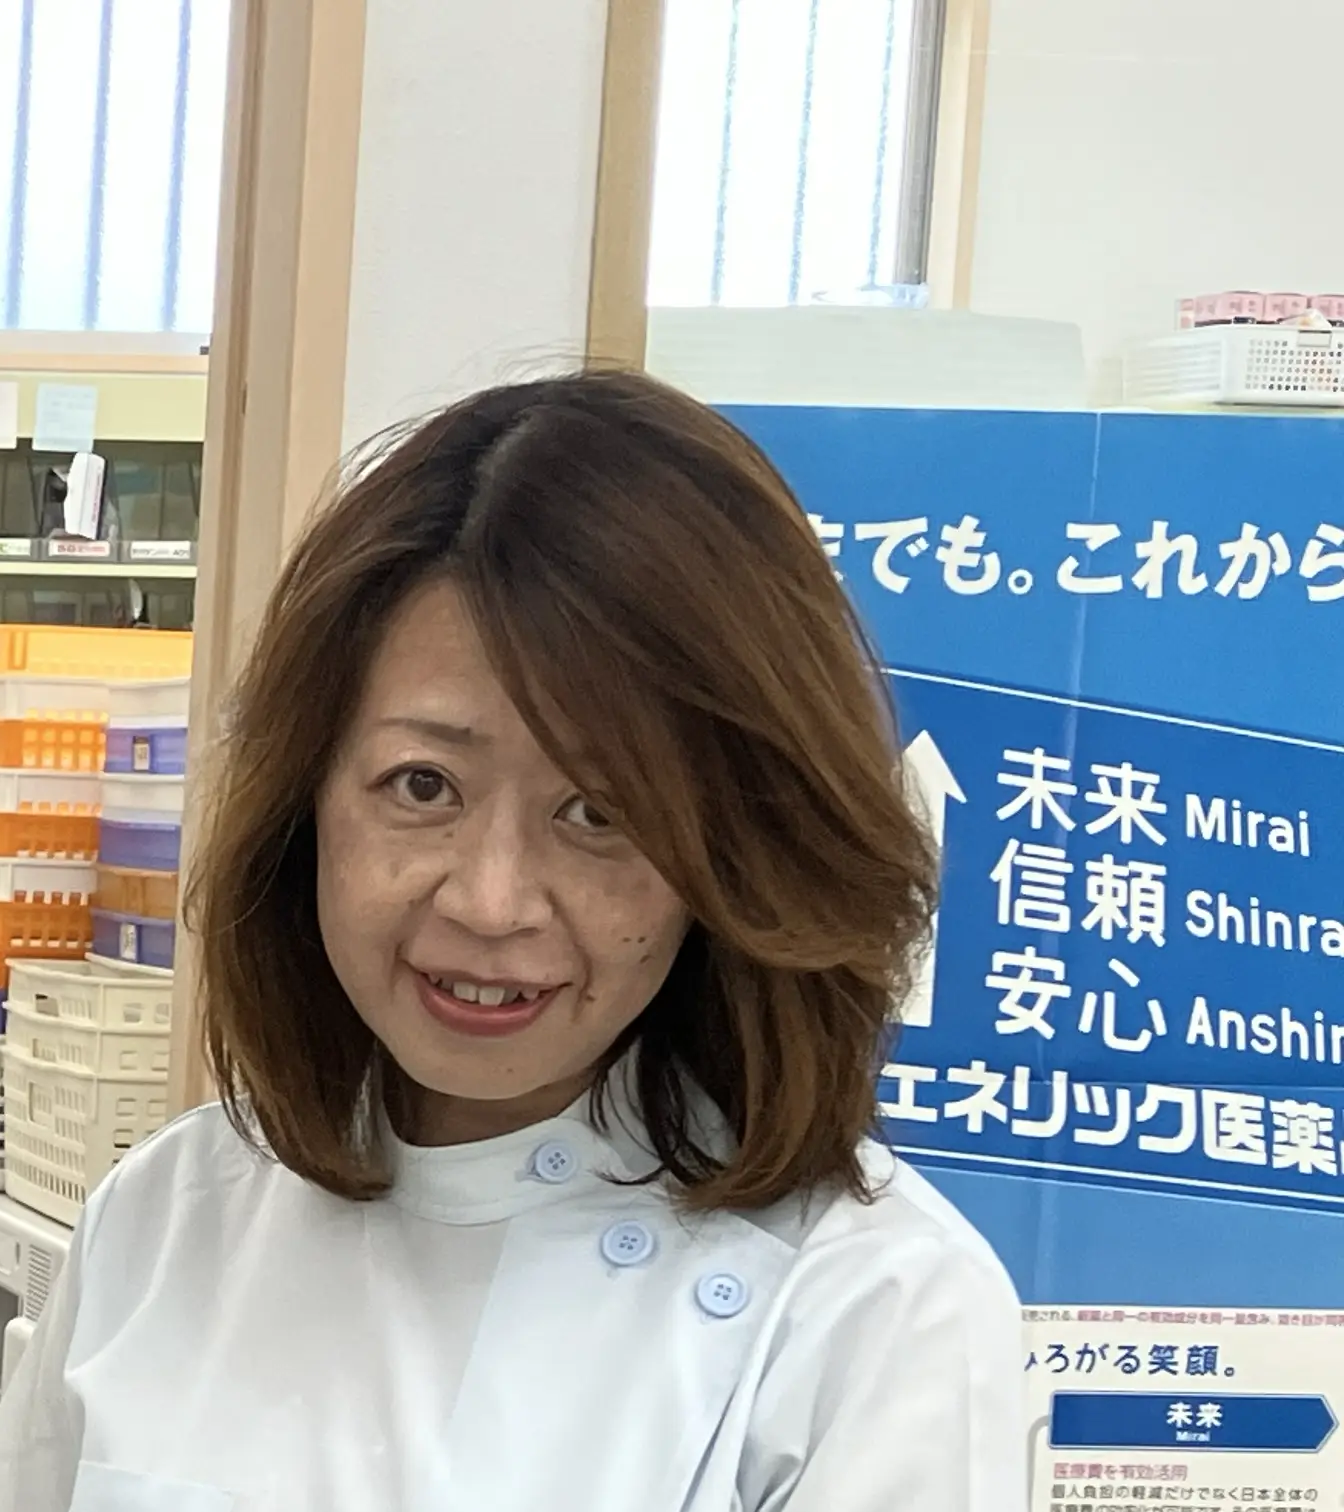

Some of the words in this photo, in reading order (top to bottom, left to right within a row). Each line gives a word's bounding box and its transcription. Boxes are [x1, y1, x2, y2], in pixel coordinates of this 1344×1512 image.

[995, 747, 1168, 847] 未来
[1184, 793, 1311, 858] Mirai
[989, 838, 1168, 948] 信頼
[1184, 888, 1344, 958] Shinra
[984, 946, 1168, 1053] 安心
[1166, 1402, 1223, 1428] 未来
